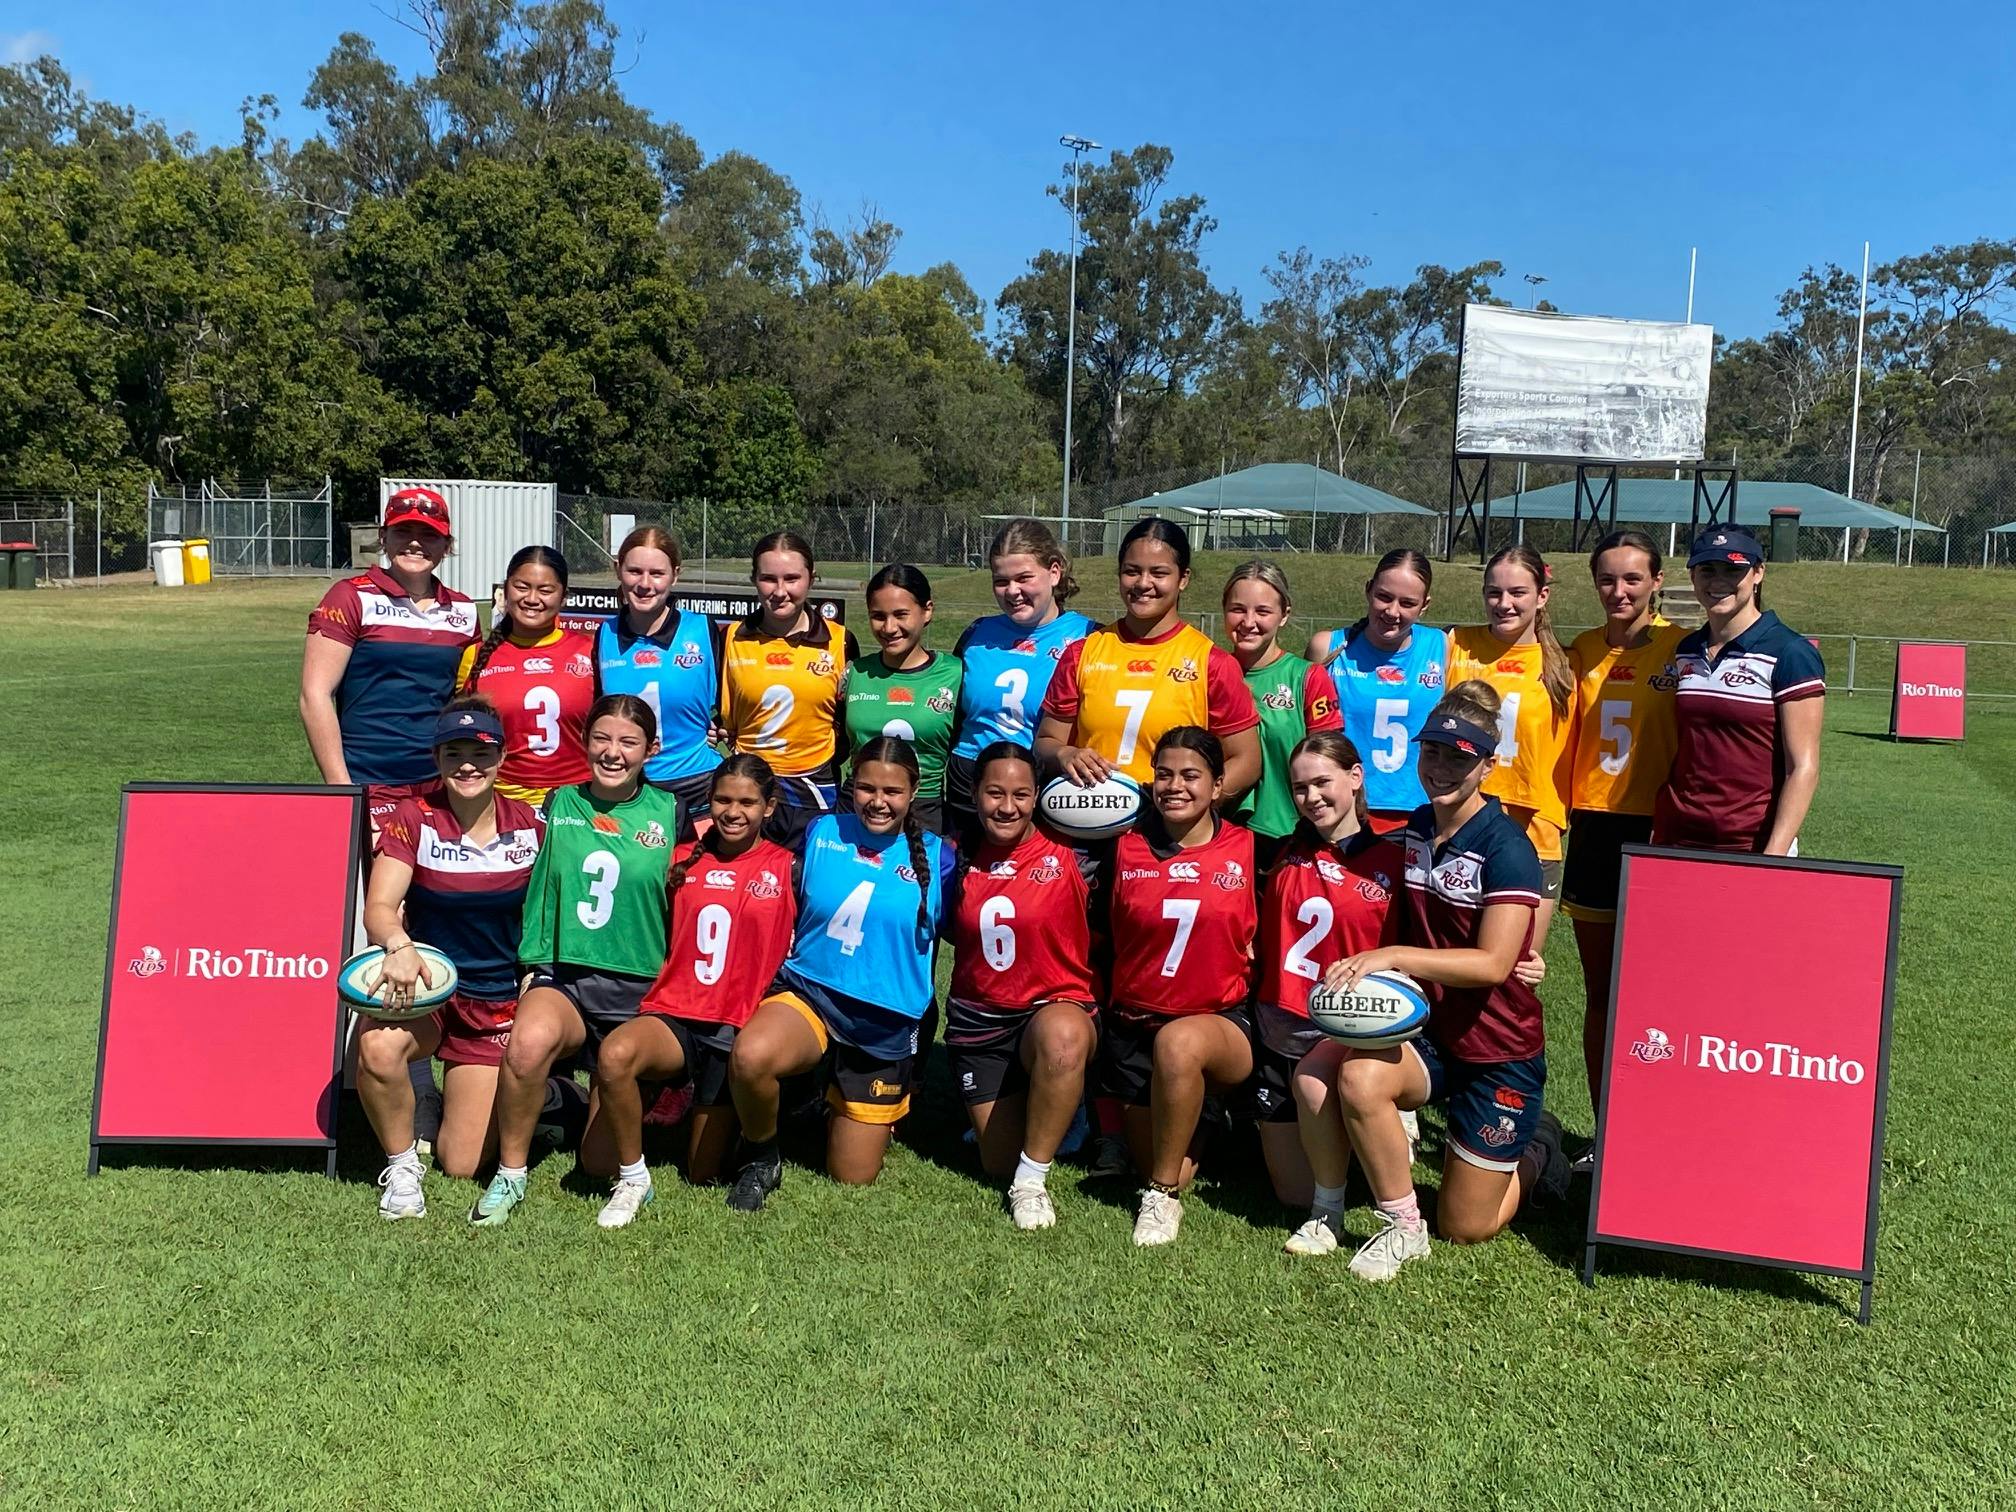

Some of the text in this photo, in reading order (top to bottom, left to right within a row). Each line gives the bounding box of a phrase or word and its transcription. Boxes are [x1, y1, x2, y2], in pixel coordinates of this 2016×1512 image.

[1474, 388, 1588, 405] Exporters Sports Complex
[375, 601, 410, 619] bms
[729, 600, 749, 616] FOR
[569, 620, 583, 630] for
[674, 654, 704, 669] REDS
[1167, 667, 1199, 683] REDS
[1719, 671, 1757, 688] REDS
[925, 696, 954, 715] REDS
[994, 667, 1029, 736] 3
[1261, 693, 1296, 711] REDS
[524, 685, 561, 757] 3
[755, 684, 795, 753] 2
[1115, 689, 1154, 765] 7
[1371, 698, 1410, 774] 5
[1599, 700, 1633, 776] 5
[1047, 794, 1132, 810] GILBERT
[633, 830, 668, 849] REDS
[430, 840, 470, 862] bms
[504, 847, 534, 865] REDS
[1028, 866, 1064, 885] REDS
[1211, 871, 1248, 892] REDS
[1439, 869, 1473, 890] REDS
[576, 850, 621, 930] 3
[745, 879, 784, 900] REDS
[826, 879, 876, 957] 4
[979, 895, 1016, 972] 6
[1160, 898, 1202, 978] 7
[1283, 896, 1335, 982] 2
[694, 903, 732, 986] 9
[127, 957, 168, 979] REDS
[1311, 994, 1401, 1014] GILBERT
[1629, 1040, 1675, 1064] REDS
[1476, 1123, 1518, 1148] REDS
